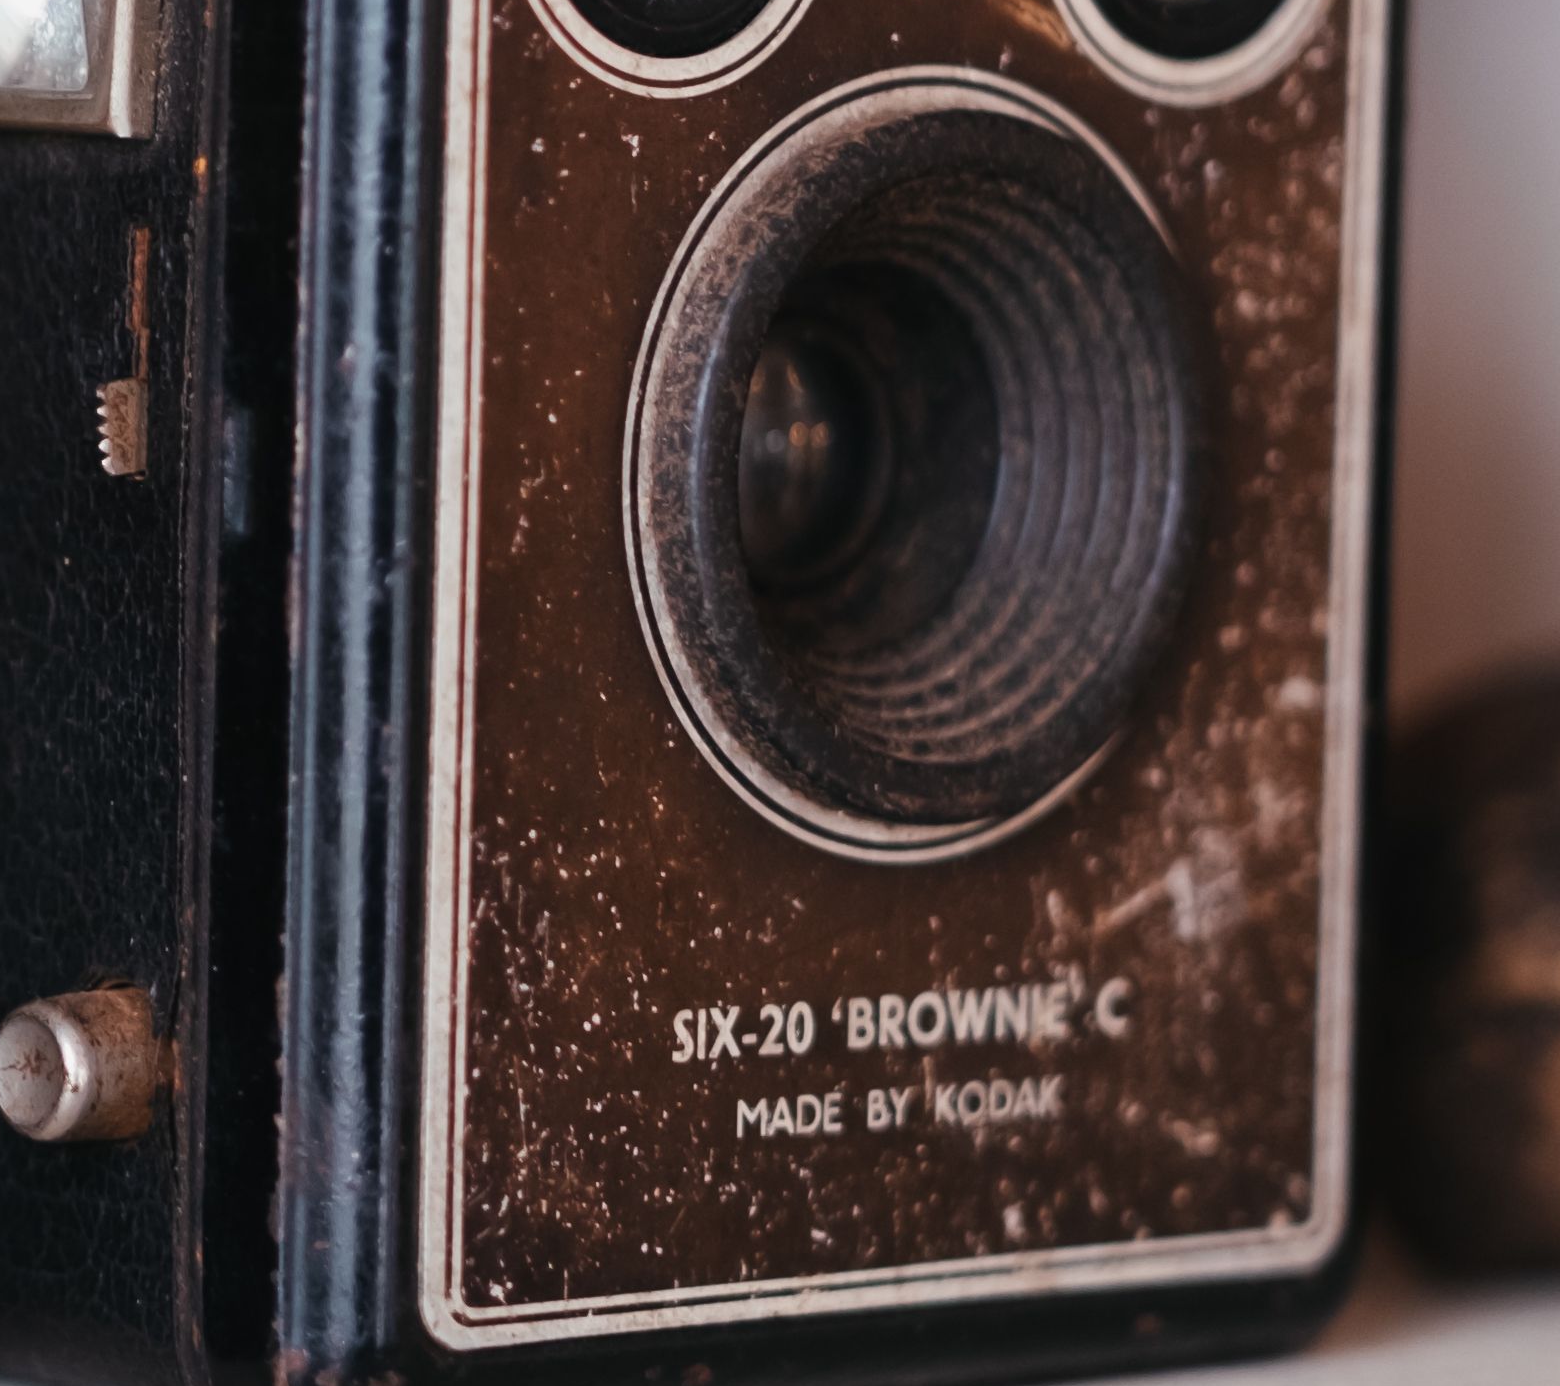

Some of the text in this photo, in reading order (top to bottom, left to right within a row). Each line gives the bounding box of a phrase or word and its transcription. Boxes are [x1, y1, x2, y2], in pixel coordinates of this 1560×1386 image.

[671, 1001, 815, 1064] SIX-20
[1095, 975, 1132, 1040] C
[736, 1074, 1065, 1139] MADE BY KODAK
